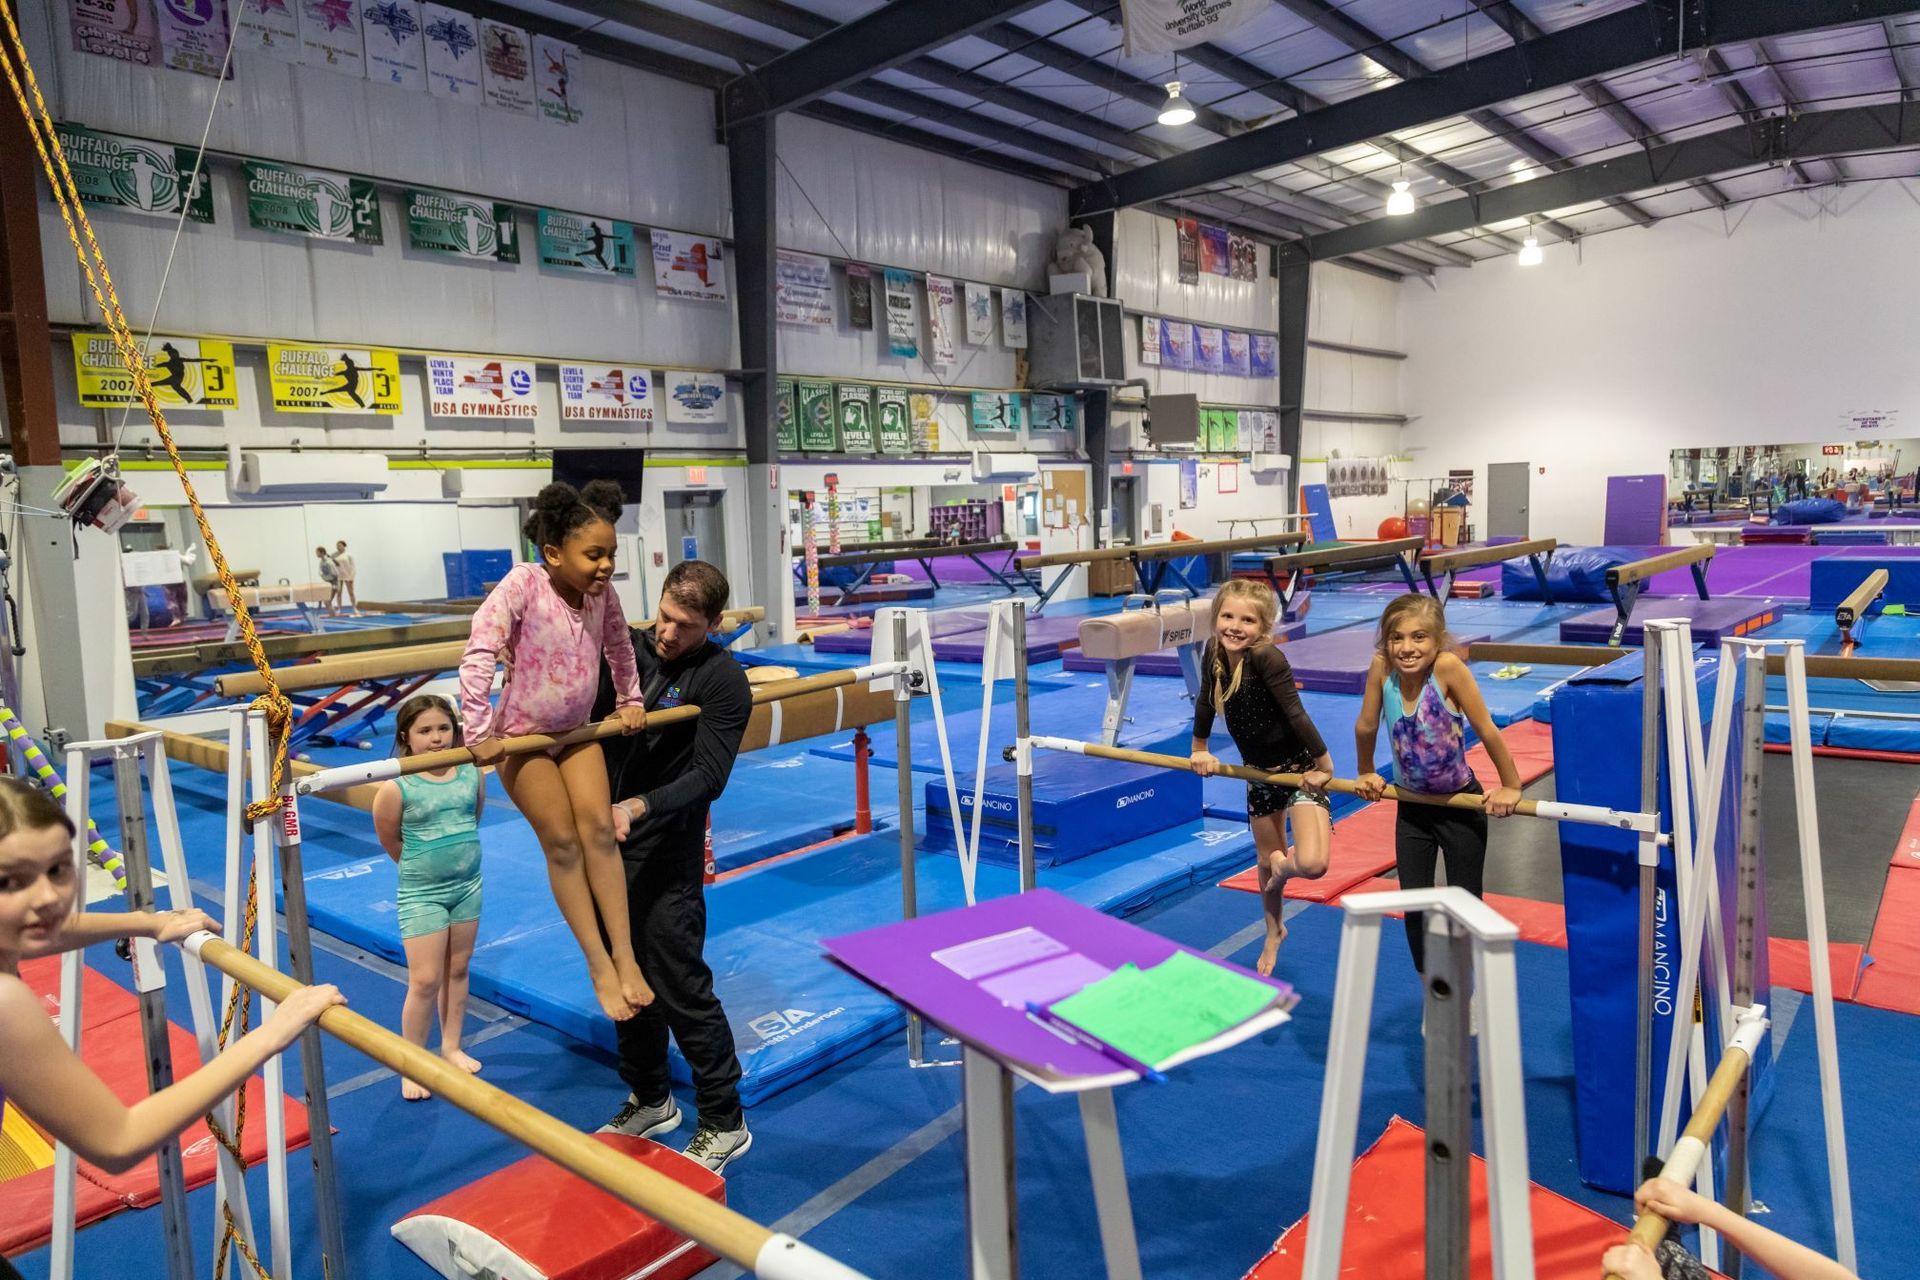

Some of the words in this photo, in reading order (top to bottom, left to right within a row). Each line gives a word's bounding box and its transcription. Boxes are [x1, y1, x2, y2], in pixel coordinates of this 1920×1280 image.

[1182, 0, 1207, 14] World
[1164, 12, 1200, 31] University
[1200, 0, 1232, 16] Games
[1178, 20, 1206, 36] Buffalo
[80, 38, 131, 61] Level
[135, 50, 150, 66] 4
[59, 133, 121, 156] BUFFALO
[256, 167, 306, 187] BUFFALO
[249, 180, 314, 201] CHALLENGE
[415, 194, 457, 211] BUFFALO
[409, 204, 463, 223] CHALLENGE
[547, 215, 583, 230] BUFFALO
[542, 226, 588, 242] CHALLENGE
[928, 283, 953, 295] JUDGES
[81, 353, 155, 369] CHALLGE
[281, 350, 329, 365] BUFFALO
[430, 360, 448, 368] LEVEL
[274, 362, 335, 378] CHALLENGE
[432, 369, 454, 377] NINTH
[562, 367, 578, 376] LEVEL
[100, 379, 135, 392] 2007
[433, 378, 454, 387] PLACE
[563, 376, 584, 384] EIGHTH
[290, 386, 319, 397] 2007
[435, 387, 454, 395] TEAM
[565, 384, 583, 392] PLACE
[567, 392, 583, 400] TEAM
[802, 388, 830, 405] CLASSIC
[433, 402, 457, 415] USA
[462, 402, 538, 417] GYMNASTICS
[565, 406, 585, 418] USA
[588, 407, 653, 420] GYMNASTICS
[843, 431, 863, 440] LEVEL
[881, 432, 901, 440] LEVEL
[1128, 789, 1155, 804] MANCINO
[982, 800, 1012, 811] ANCINO
[284, 811, 298, 837] GMR
[1654, 922, 1673, 1016] MANCINO
[788, 1006, 846, 1036] Anderson
